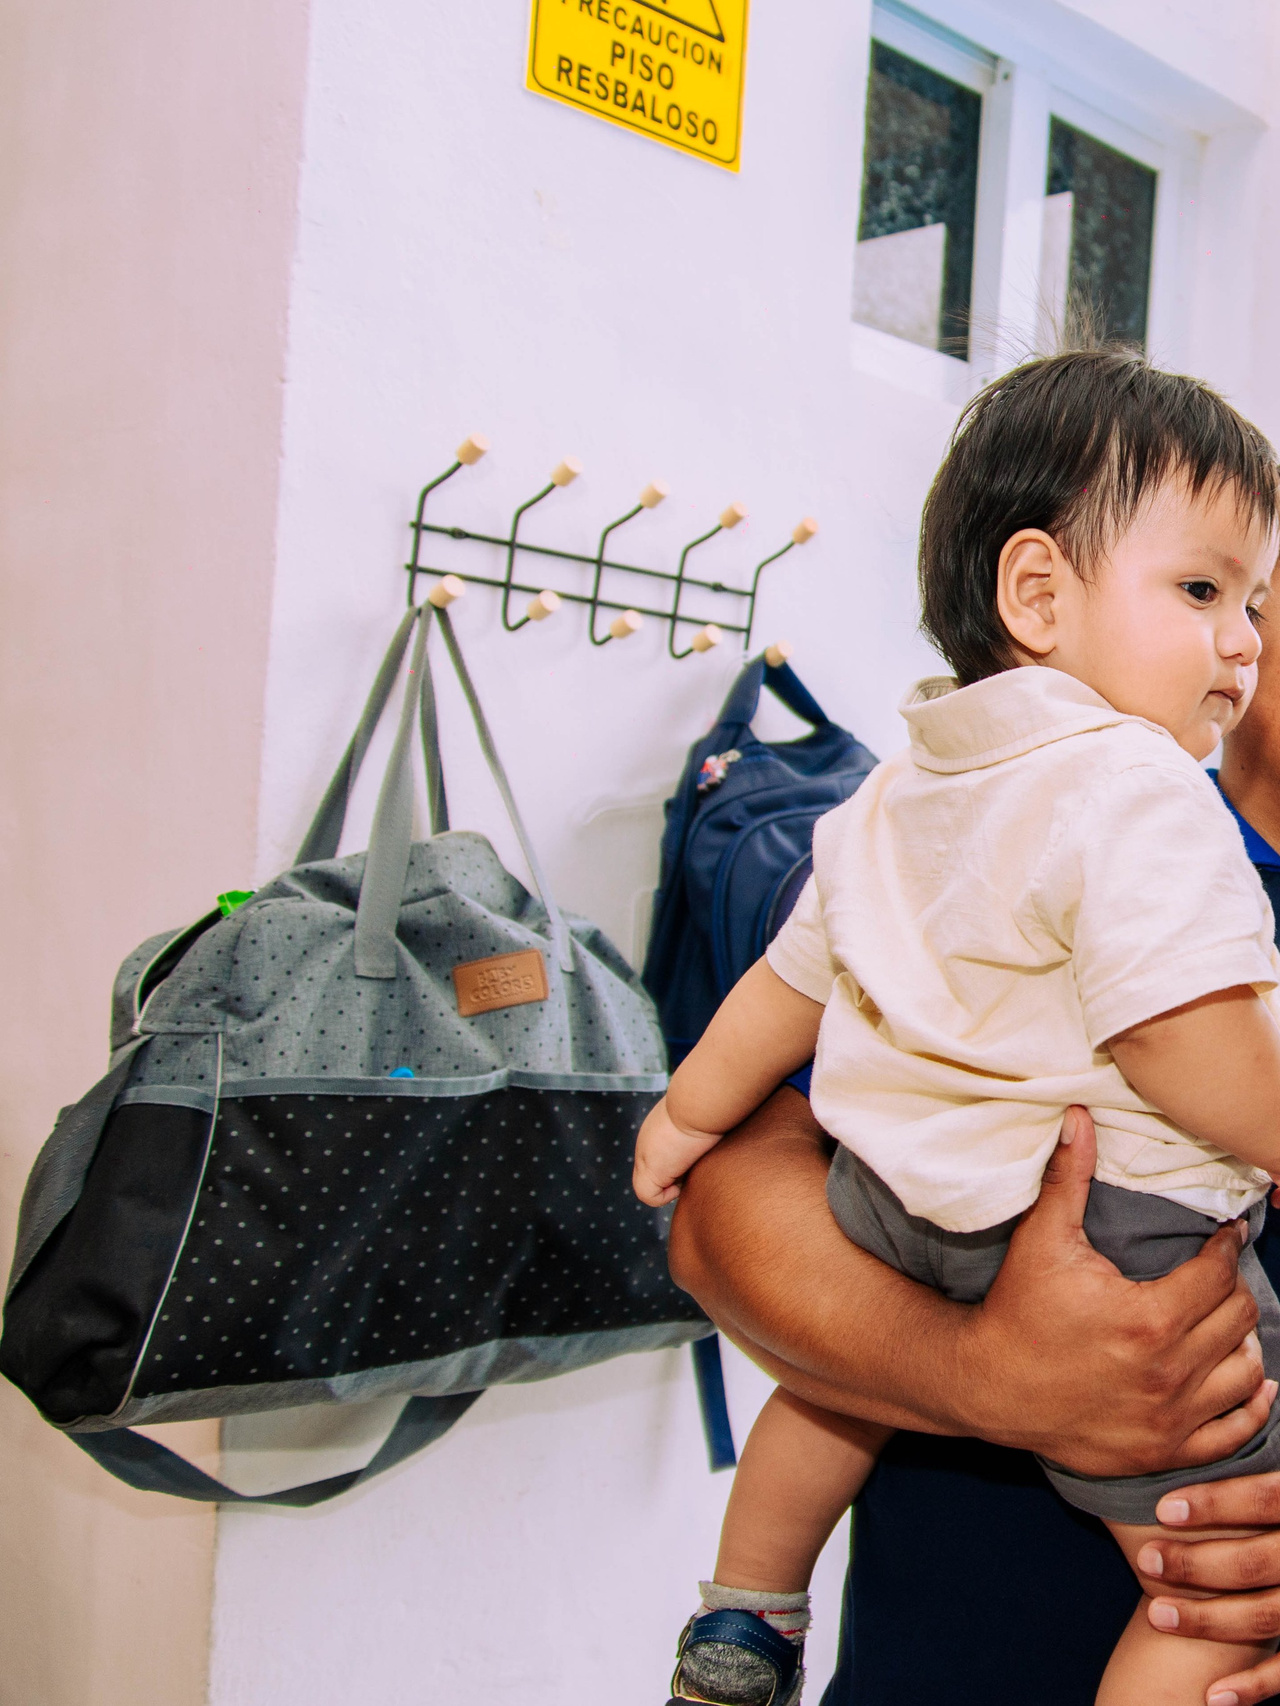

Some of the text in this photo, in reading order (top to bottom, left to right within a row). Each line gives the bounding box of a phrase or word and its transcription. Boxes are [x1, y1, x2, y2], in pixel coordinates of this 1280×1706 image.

[561, 0, 722, 74] RECAUCION
[610, 40, 675, 91] PISO
[556, 54, 718, 146] RESBALOSO
[470, 974, 535, 1003] COLORS
